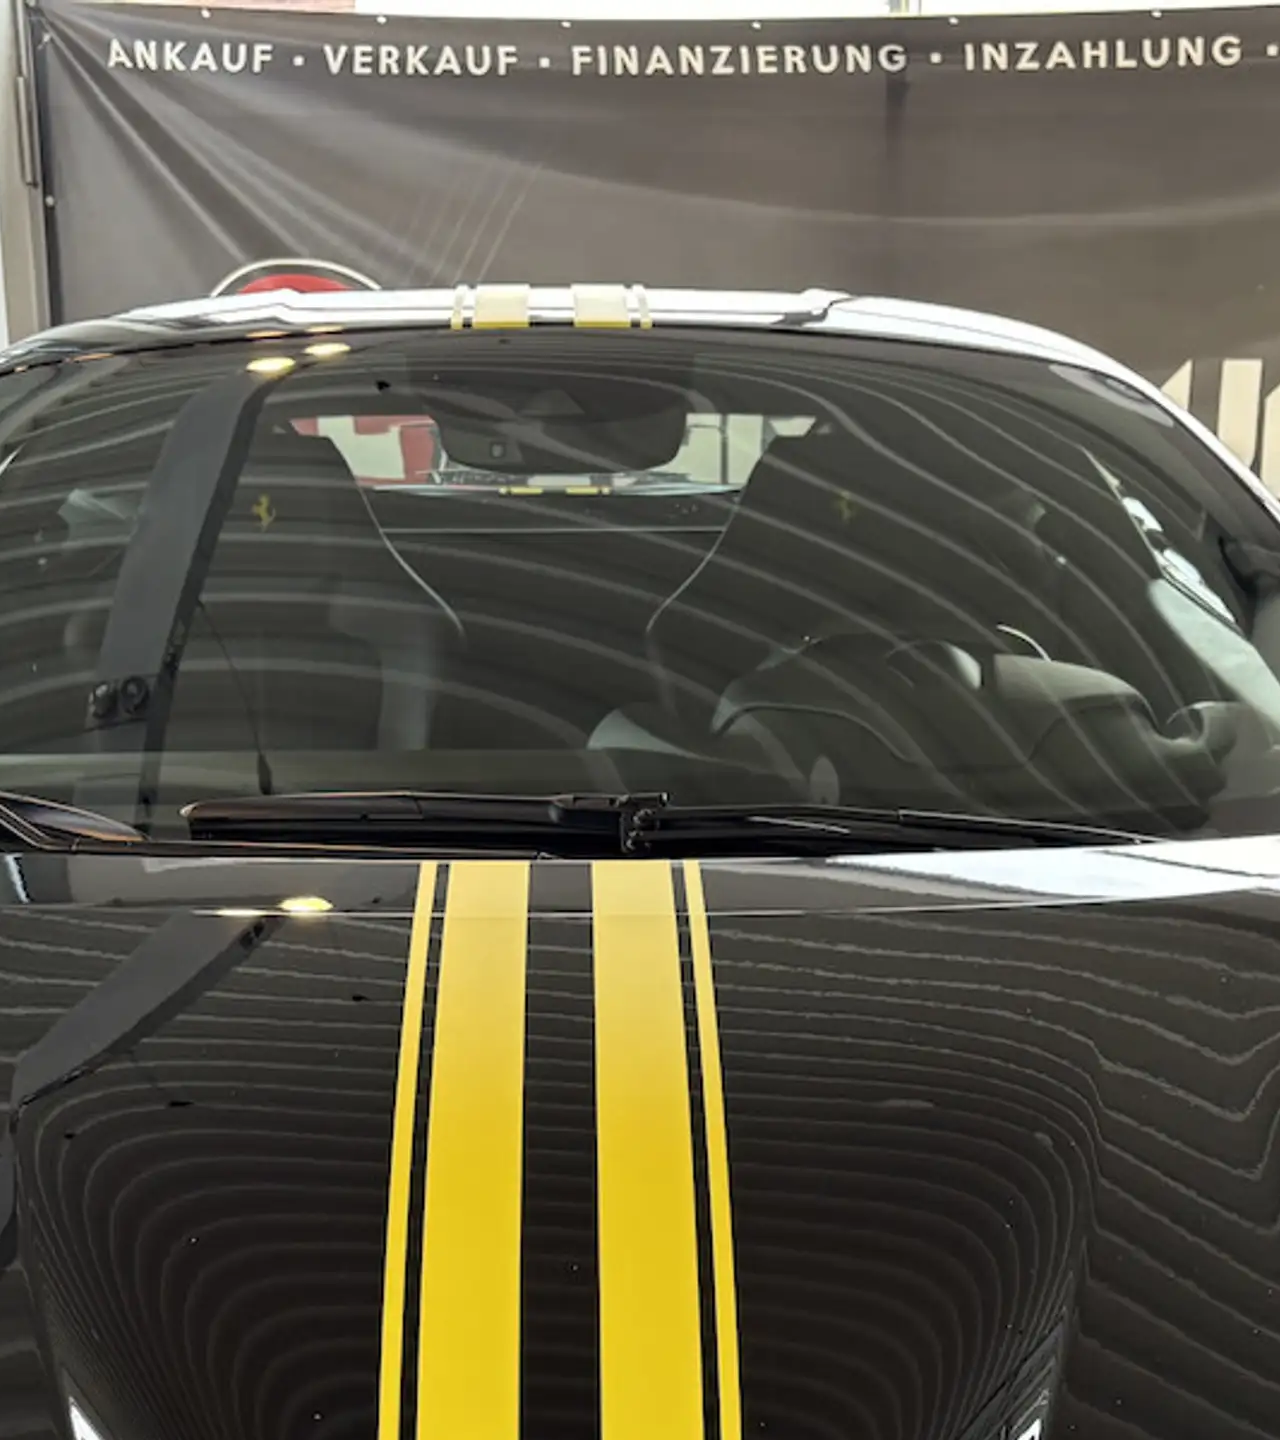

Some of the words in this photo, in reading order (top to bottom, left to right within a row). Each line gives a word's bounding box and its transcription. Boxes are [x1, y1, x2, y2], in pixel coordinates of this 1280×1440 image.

[107, 39, 274, 75] ANKAUF
[324, 44, 518, 77] VERKAUF
[571, 43, 907, 77] FINANZIERUNG
[964, 35, 1243, 71] INZAHLUNG
